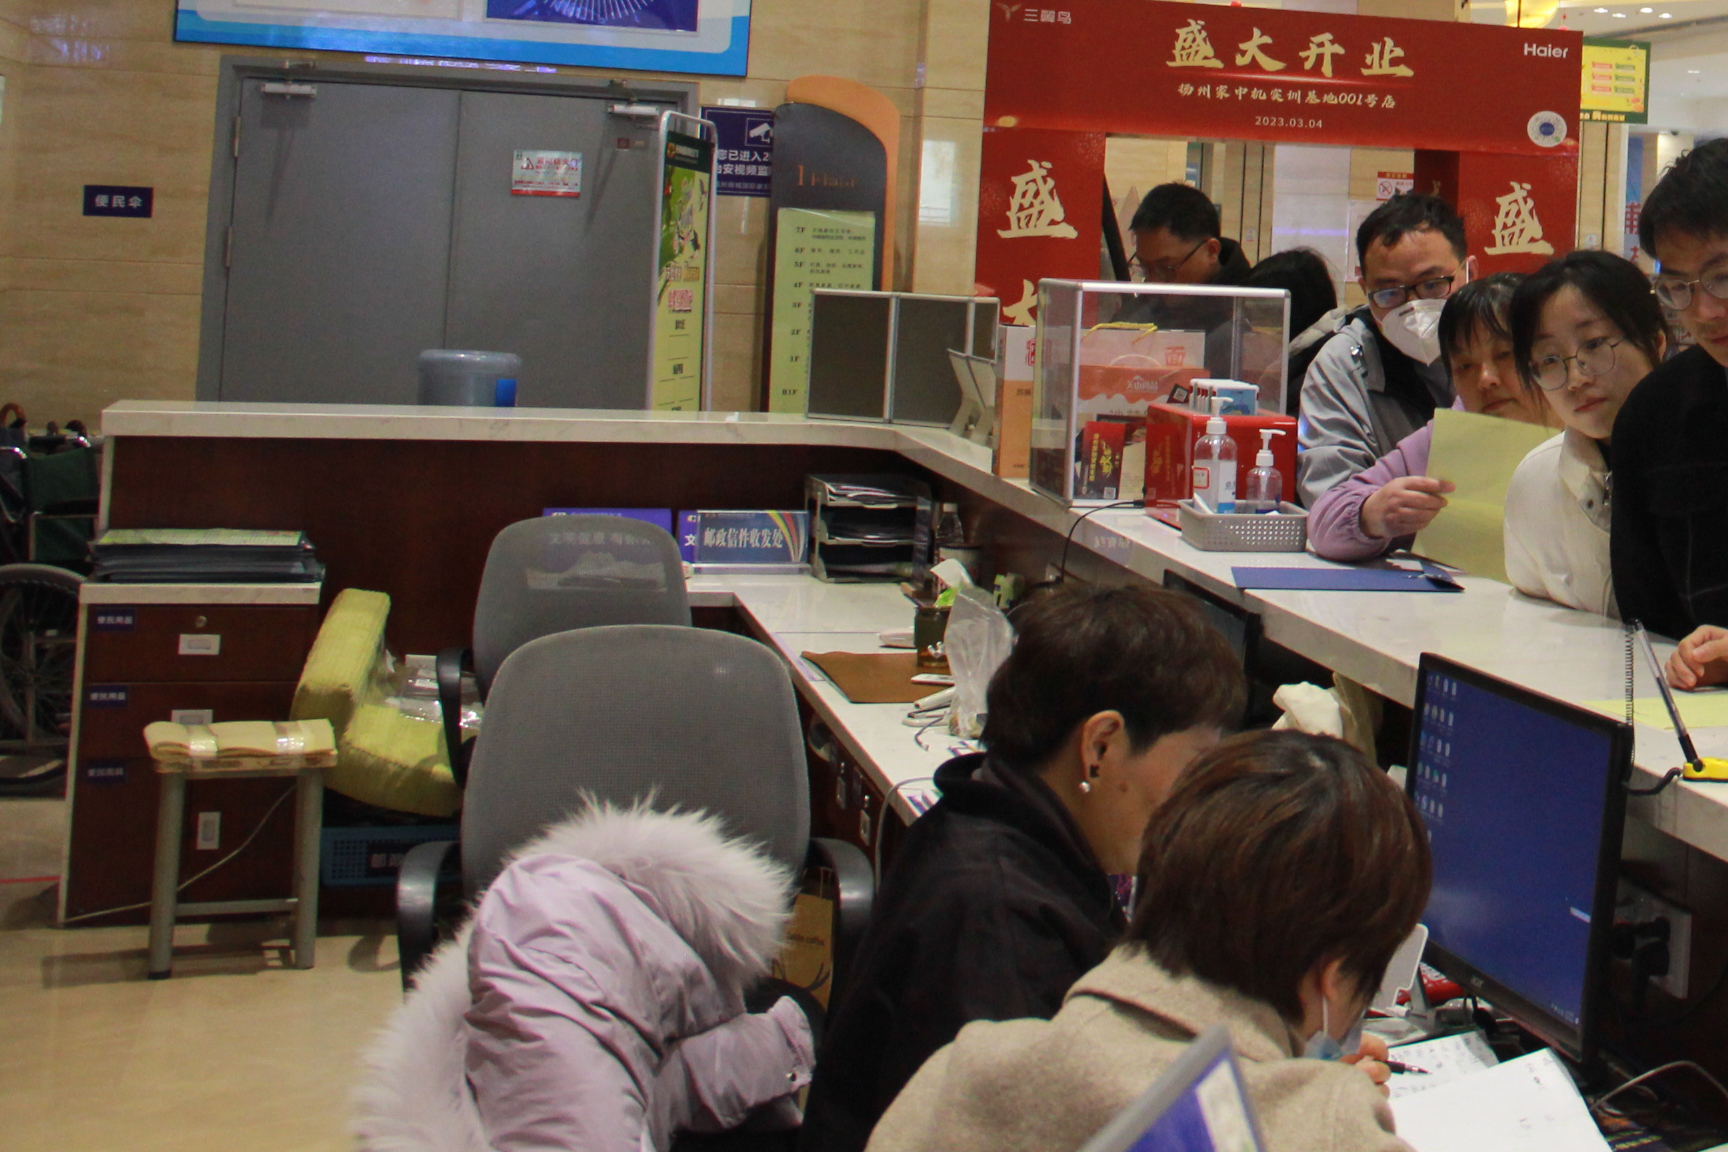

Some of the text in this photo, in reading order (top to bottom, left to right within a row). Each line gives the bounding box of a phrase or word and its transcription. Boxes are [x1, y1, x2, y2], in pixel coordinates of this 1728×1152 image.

[1166, 18, 1415, 78] 盛大开业
[1523, 42, 1569, 58] Haier
[1255, 116, 1323, 129] 2023.03.04
[1483, 181, 1555, 256] 盛
[703, 526, 784, 550] 邮政信件收发处
